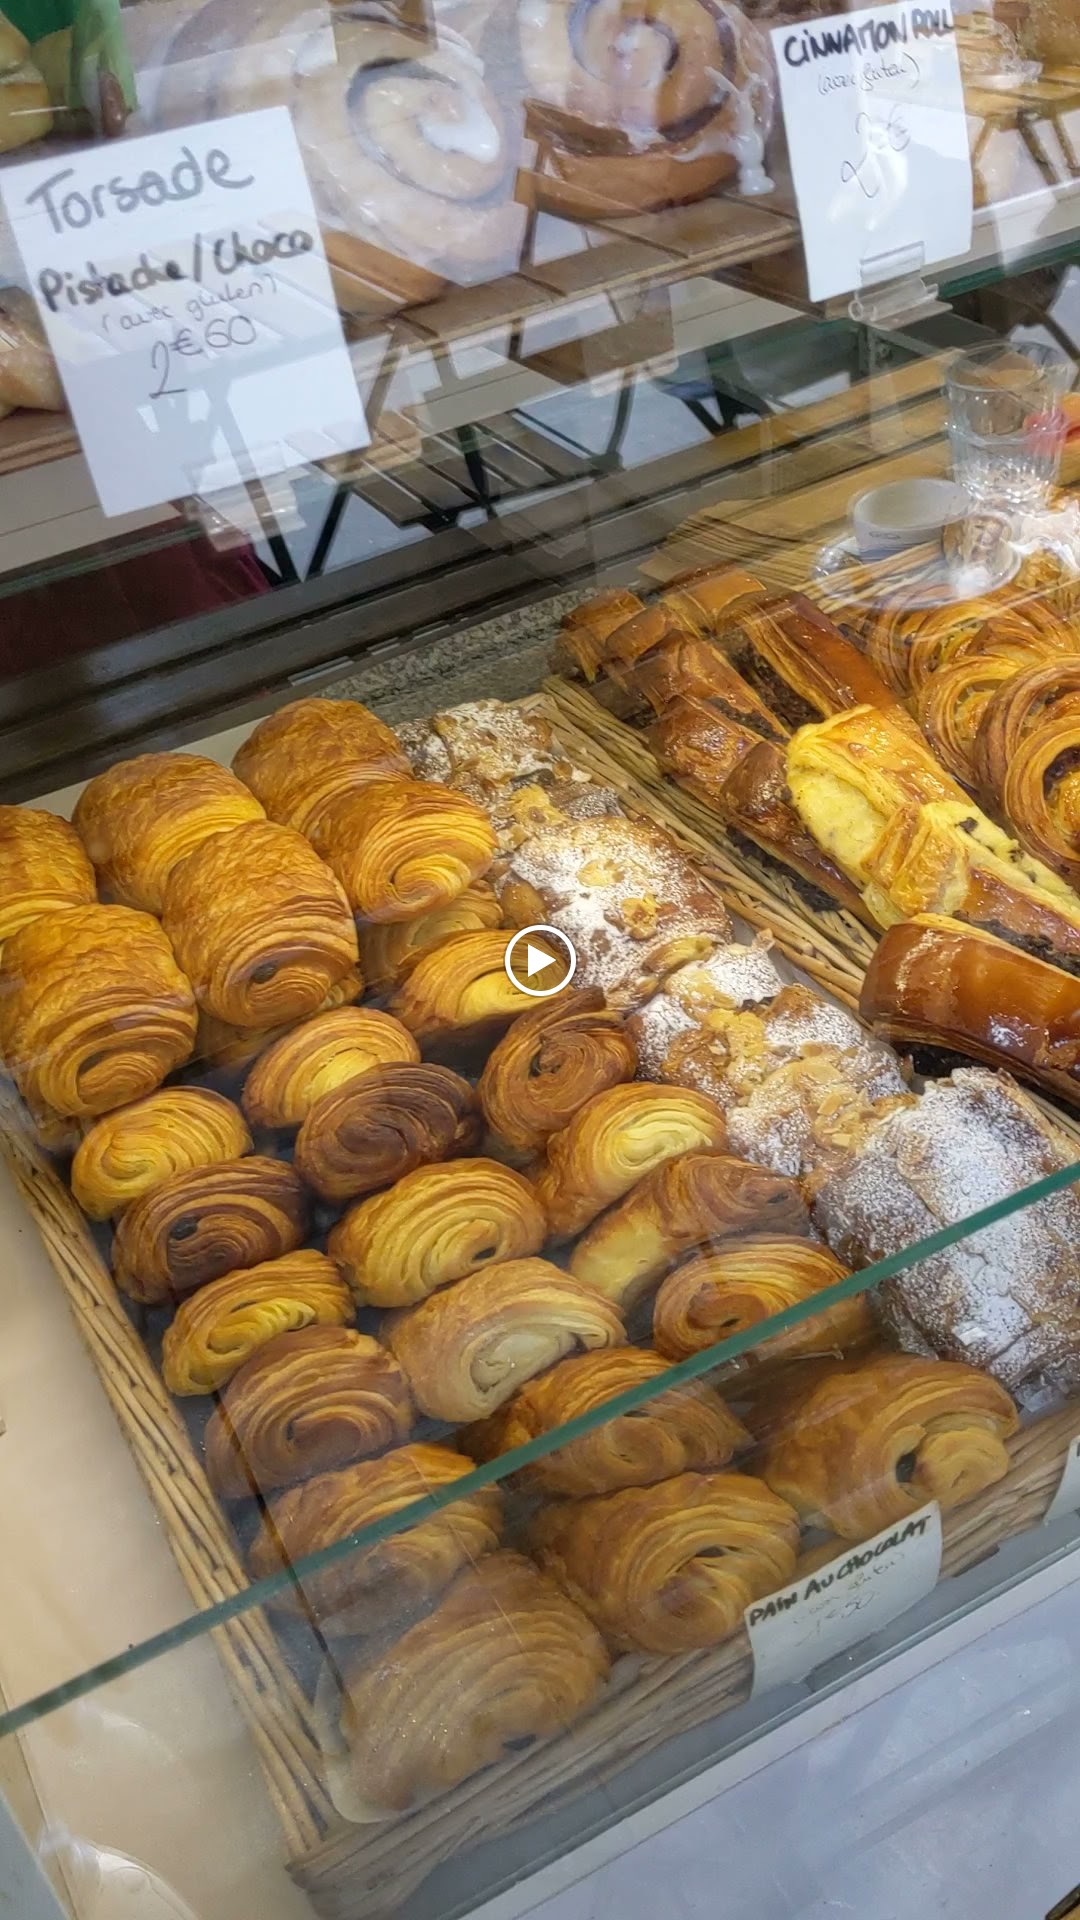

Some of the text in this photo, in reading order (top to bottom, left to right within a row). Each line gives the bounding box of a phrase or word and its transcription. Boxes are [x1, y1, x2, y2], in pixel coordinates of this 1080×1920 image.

[26, 146, 254, 233] Torsade
[149, 315, 256, 399] 2€60
[837, 1515, 931, 1580] CHOCOLAT
